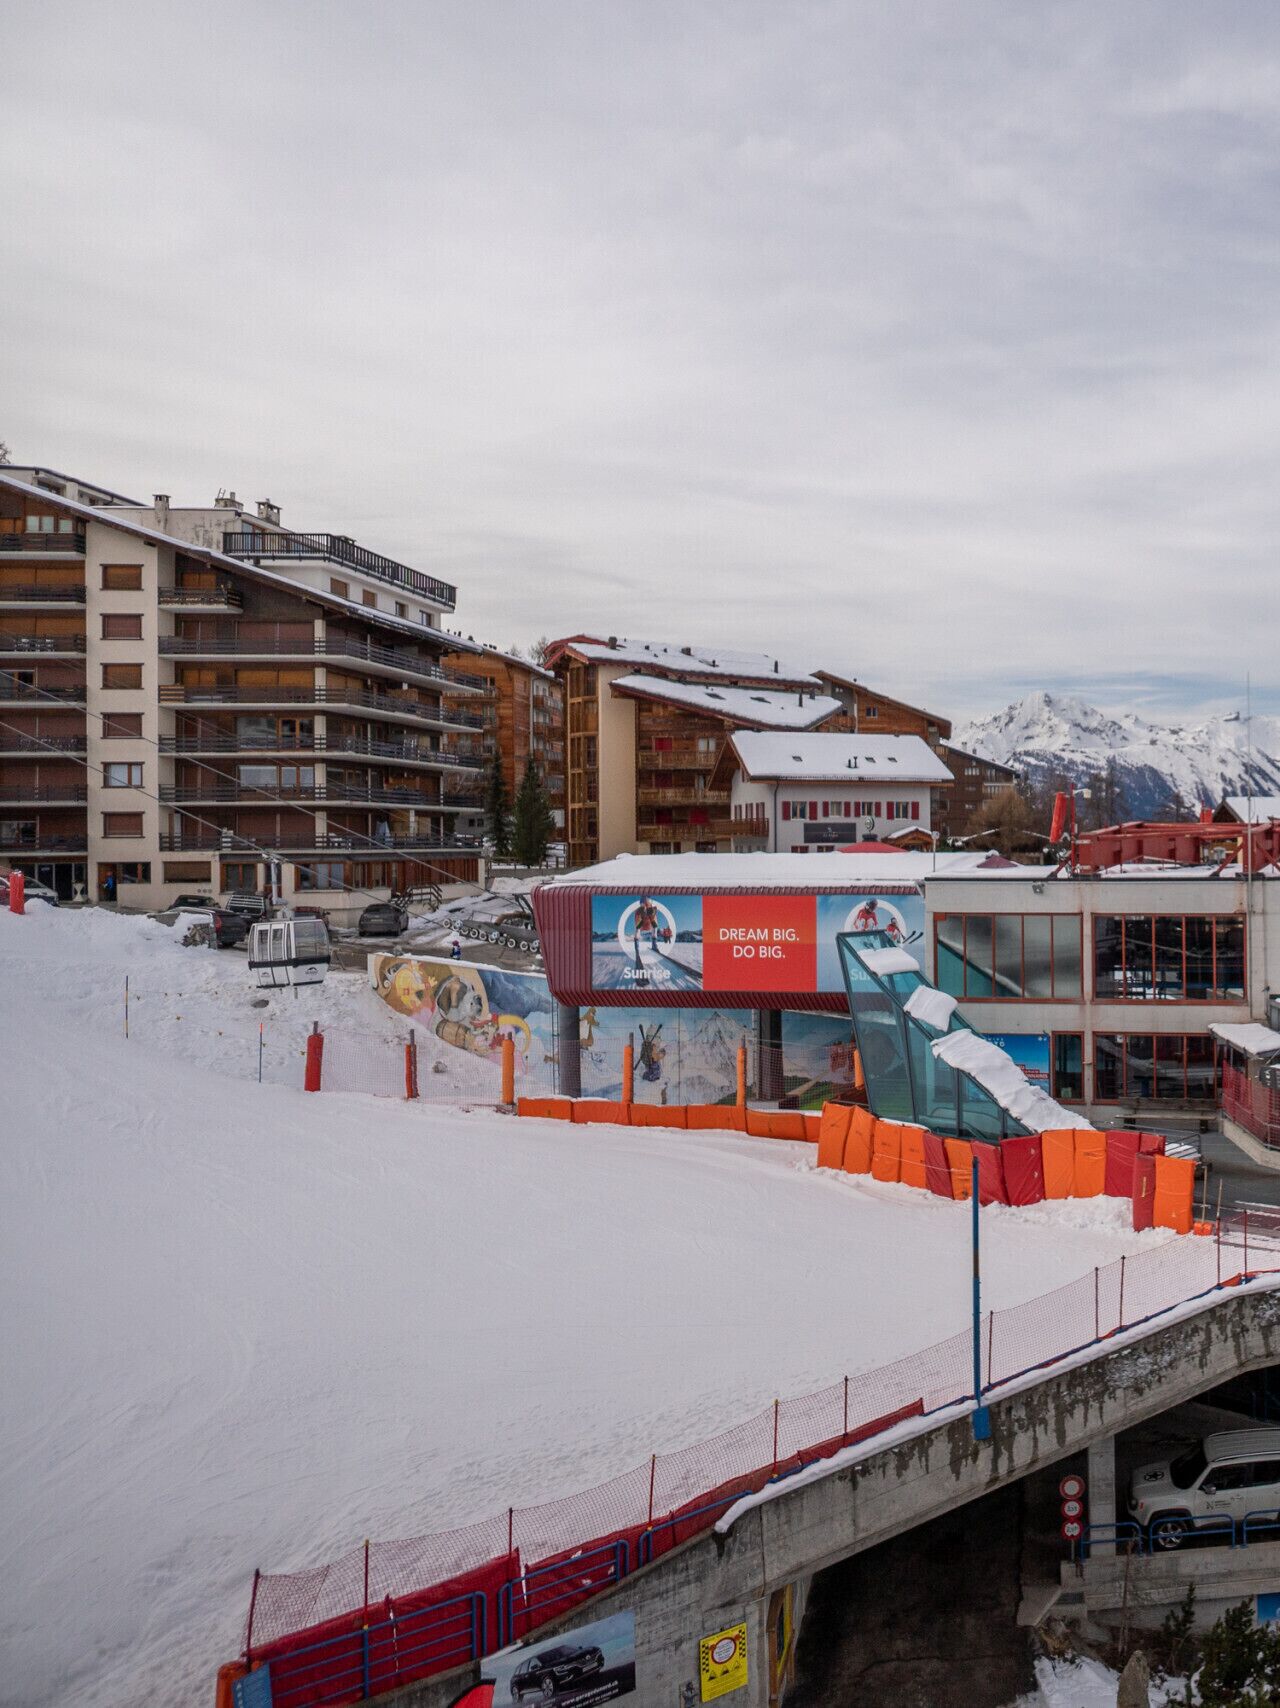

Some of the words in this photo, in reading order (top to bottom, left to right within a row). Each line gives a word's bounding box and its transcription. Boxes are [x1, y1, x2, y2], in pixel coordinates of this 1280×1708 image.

[719, 927, 770, 942] DREAM
[772, 927, 800, 942] BIG.
[732, 945, 755, 959] DO
[758, 945, 787, 959] BIG.
[623, 966, 671, 979] Sunrise
